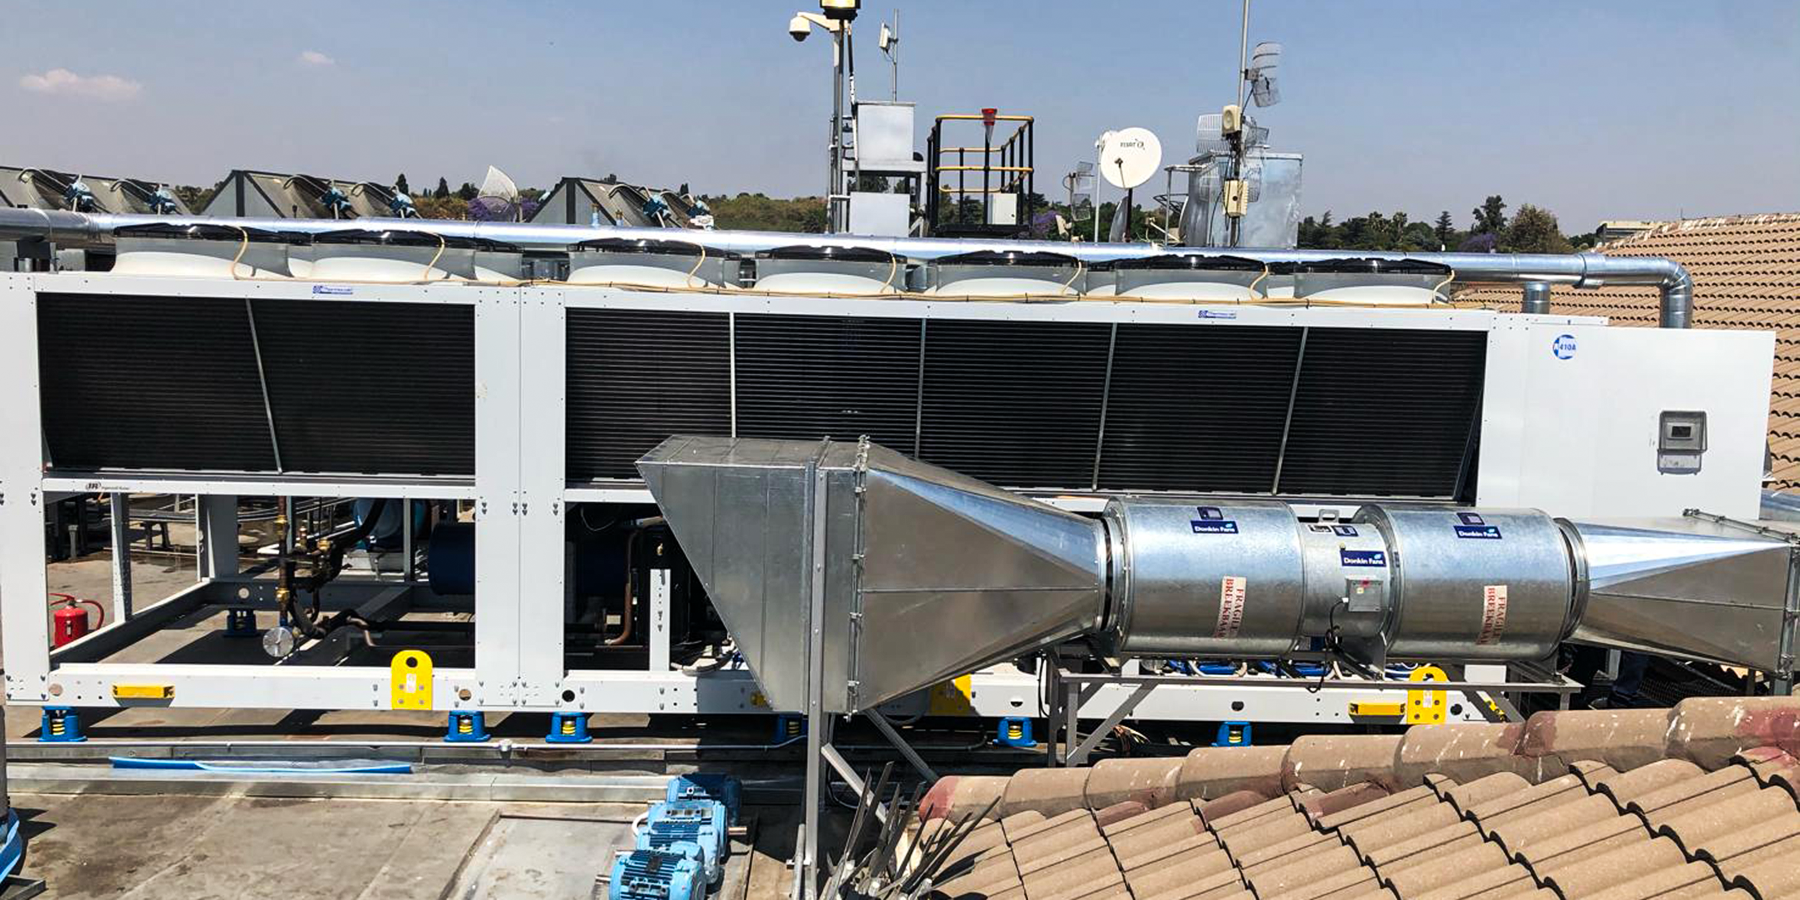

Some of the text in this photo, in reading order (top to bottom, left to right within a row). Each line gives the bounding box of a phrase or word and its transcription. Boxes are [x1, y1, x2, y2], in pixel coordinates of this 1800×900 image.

[1369, 557, 1384, 565] Fans
[1230, 588, 1244, 630] FRAGILE
[1492, 596, 1506, 638] FRAGILE
